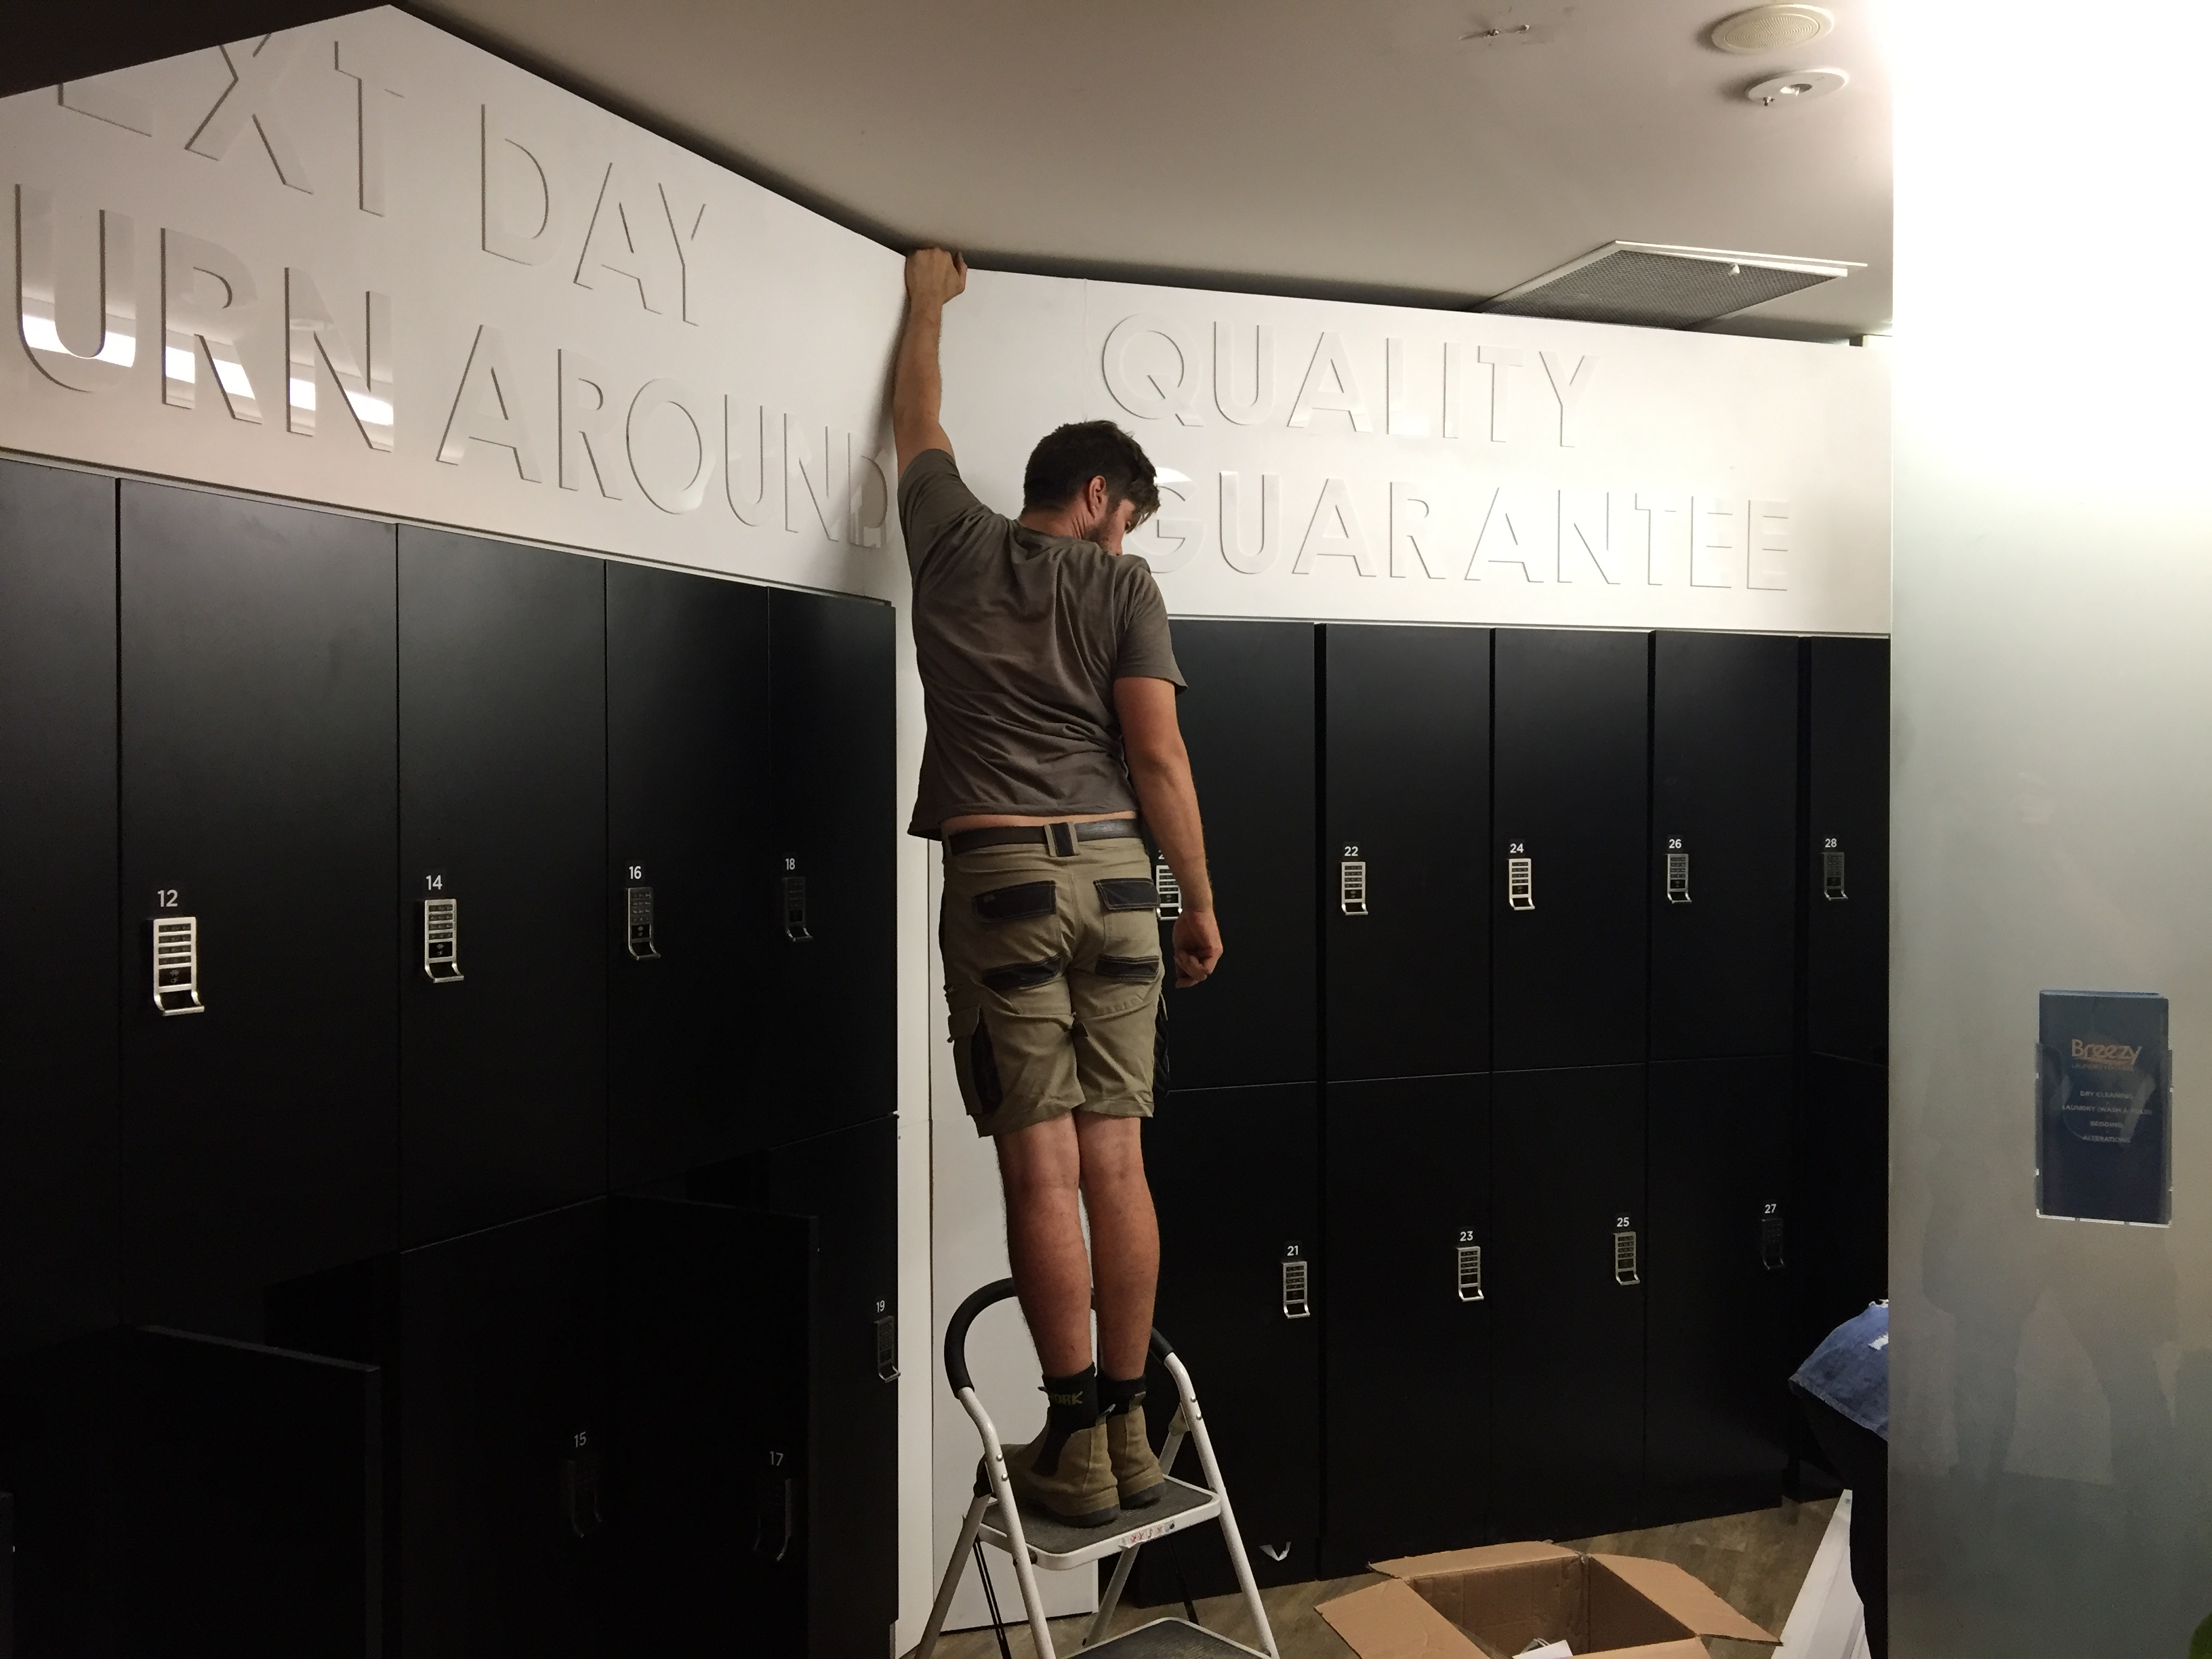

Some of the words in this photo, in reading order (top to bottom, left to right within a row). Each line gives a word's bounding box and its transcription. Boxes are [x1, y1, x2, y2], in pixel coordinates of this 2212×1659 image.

[480, 103, 717, 327] DAY
[14, 183, 396, 453] URN
[436, 324, 890, 548] AROUND
[1101, 312, 1601, 447] QUALITY
[1509, 842, 1524, 855] 24
[1668, 838, 1682, 850] 26
[1824, 837, 1837, 849] 28
[1343, 845, 1359, 857] 22
[785, 857, 796, 870] 18
[629, 865, 642, 880] 16
[425, 874, 444, 891] 14
[157, 888, 179, 908] 12
[2071, 1038, 2142, 1065] Breezy
[1763, 1202, 1777, 1214] 27
[1616, 1216, 1630, 1228] 25
[1460, 1229, 1474, 1243] 23
[1286, 1244, 1299, 1257] 21
[876, 1299, 886, 1313] 19
[573, 1431, 588, 1449] 15
[769, 1450, 785, 1467] 17
